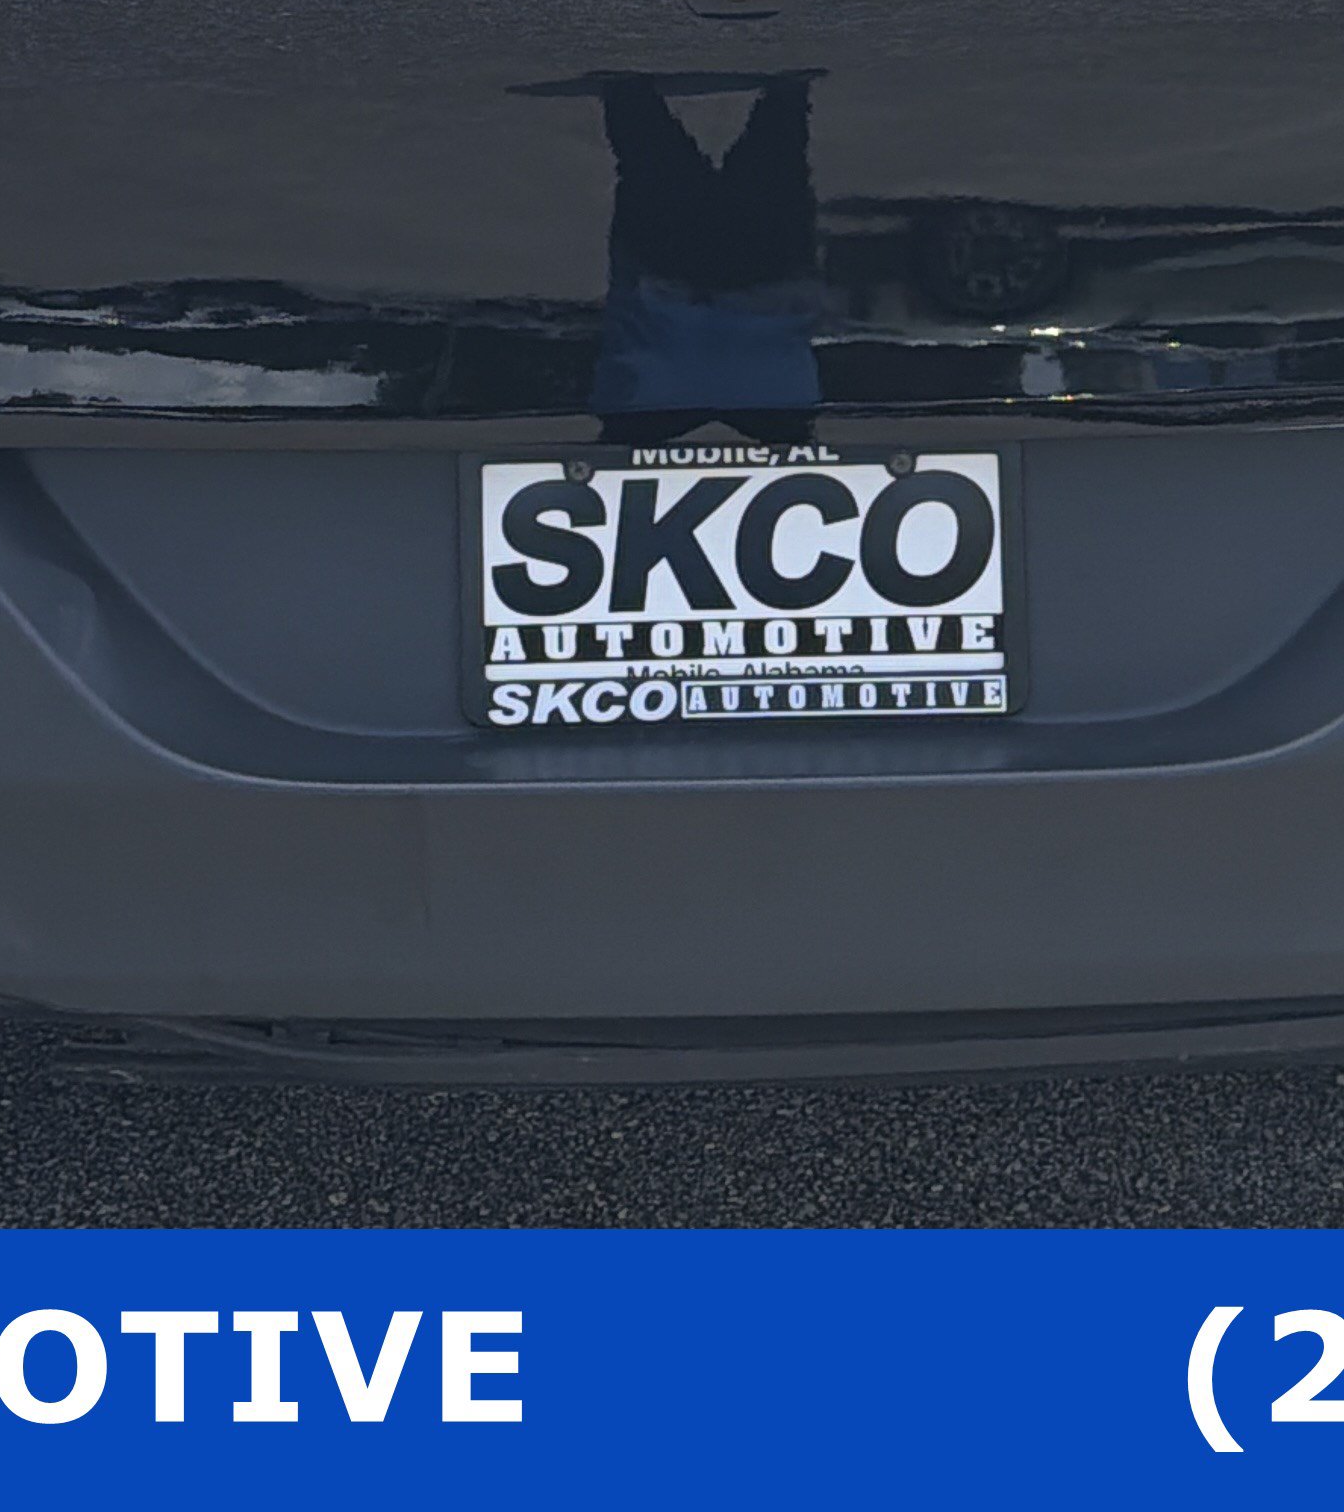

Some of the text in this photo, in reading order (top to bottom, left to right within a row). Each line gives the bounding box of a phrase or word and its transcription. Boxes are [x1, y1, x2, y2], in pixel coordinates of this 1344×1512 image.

[490, 469, 995, 617] SKCO
[489, 615, 996, 662] AUTOMOTIVE
[487, 680, 1002, 726] SKCO AUTOMOTIVE
